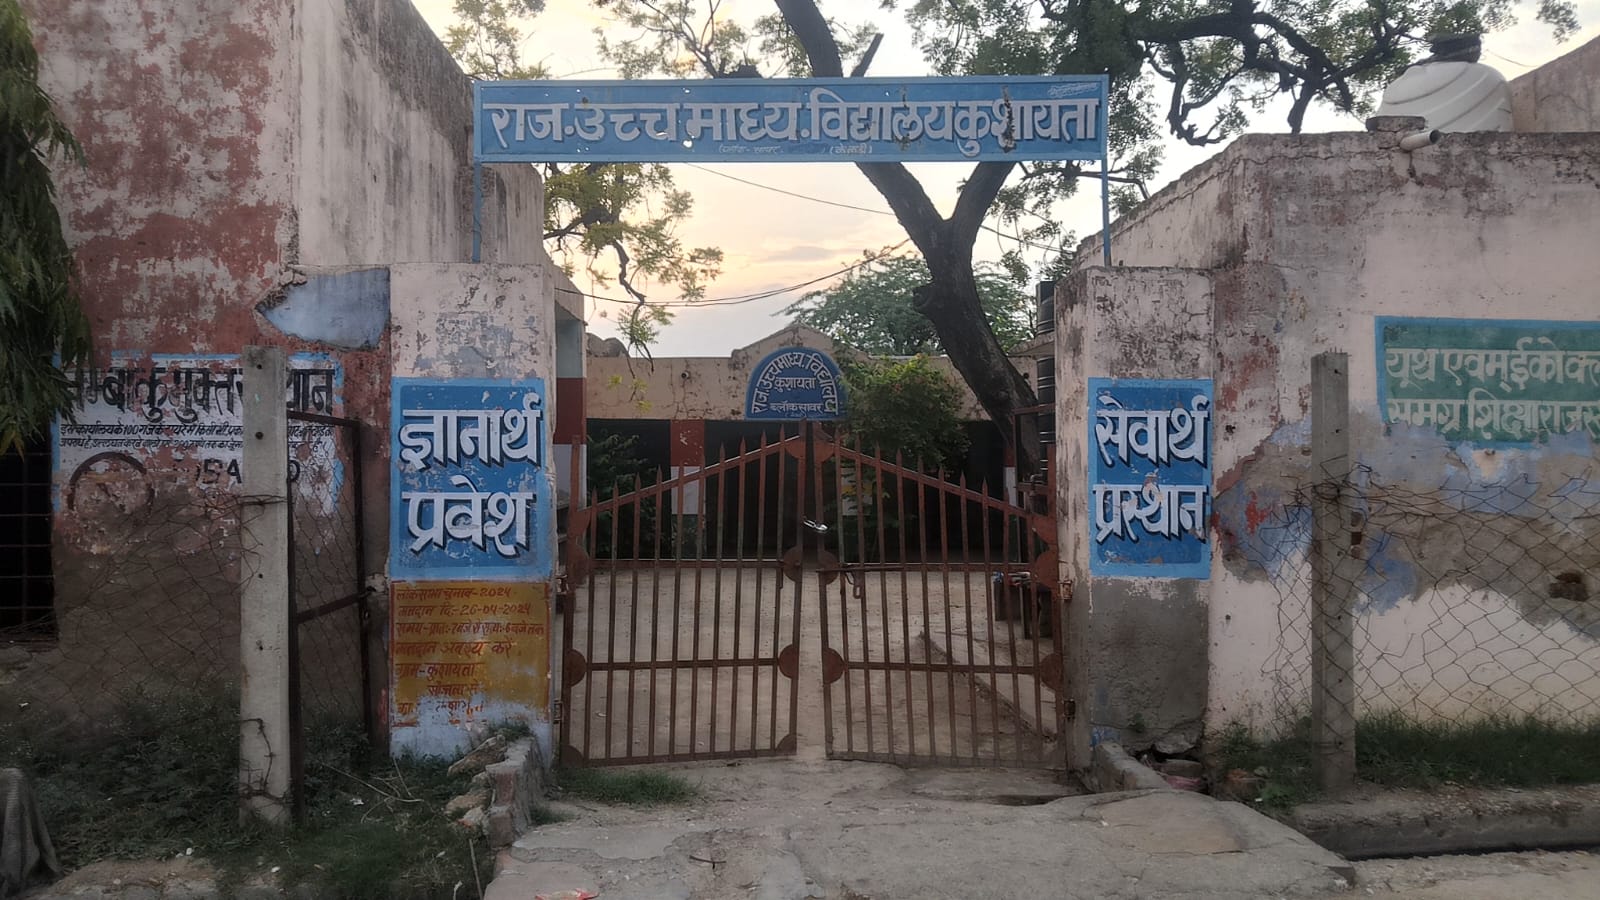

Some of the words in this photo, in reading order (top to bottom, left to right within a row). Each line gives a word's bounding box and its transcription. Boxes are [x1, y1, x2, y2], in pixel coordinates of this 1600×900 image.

[774, 377, 817, 393] कुशायता
[1385, 348, 1439, 391] यूथ
[1510, 336, 1565, 390] ईको
[400, 392, 541, 471] ज्ञानार्थ
[1096, 395, 1209, 466] सेवार्थ
[1464, 388, 1540, 440] शिक्षा
[401, 475, 535, 557] प्रवेश
[1093, 484, 1207, 543] प्रस्थान
